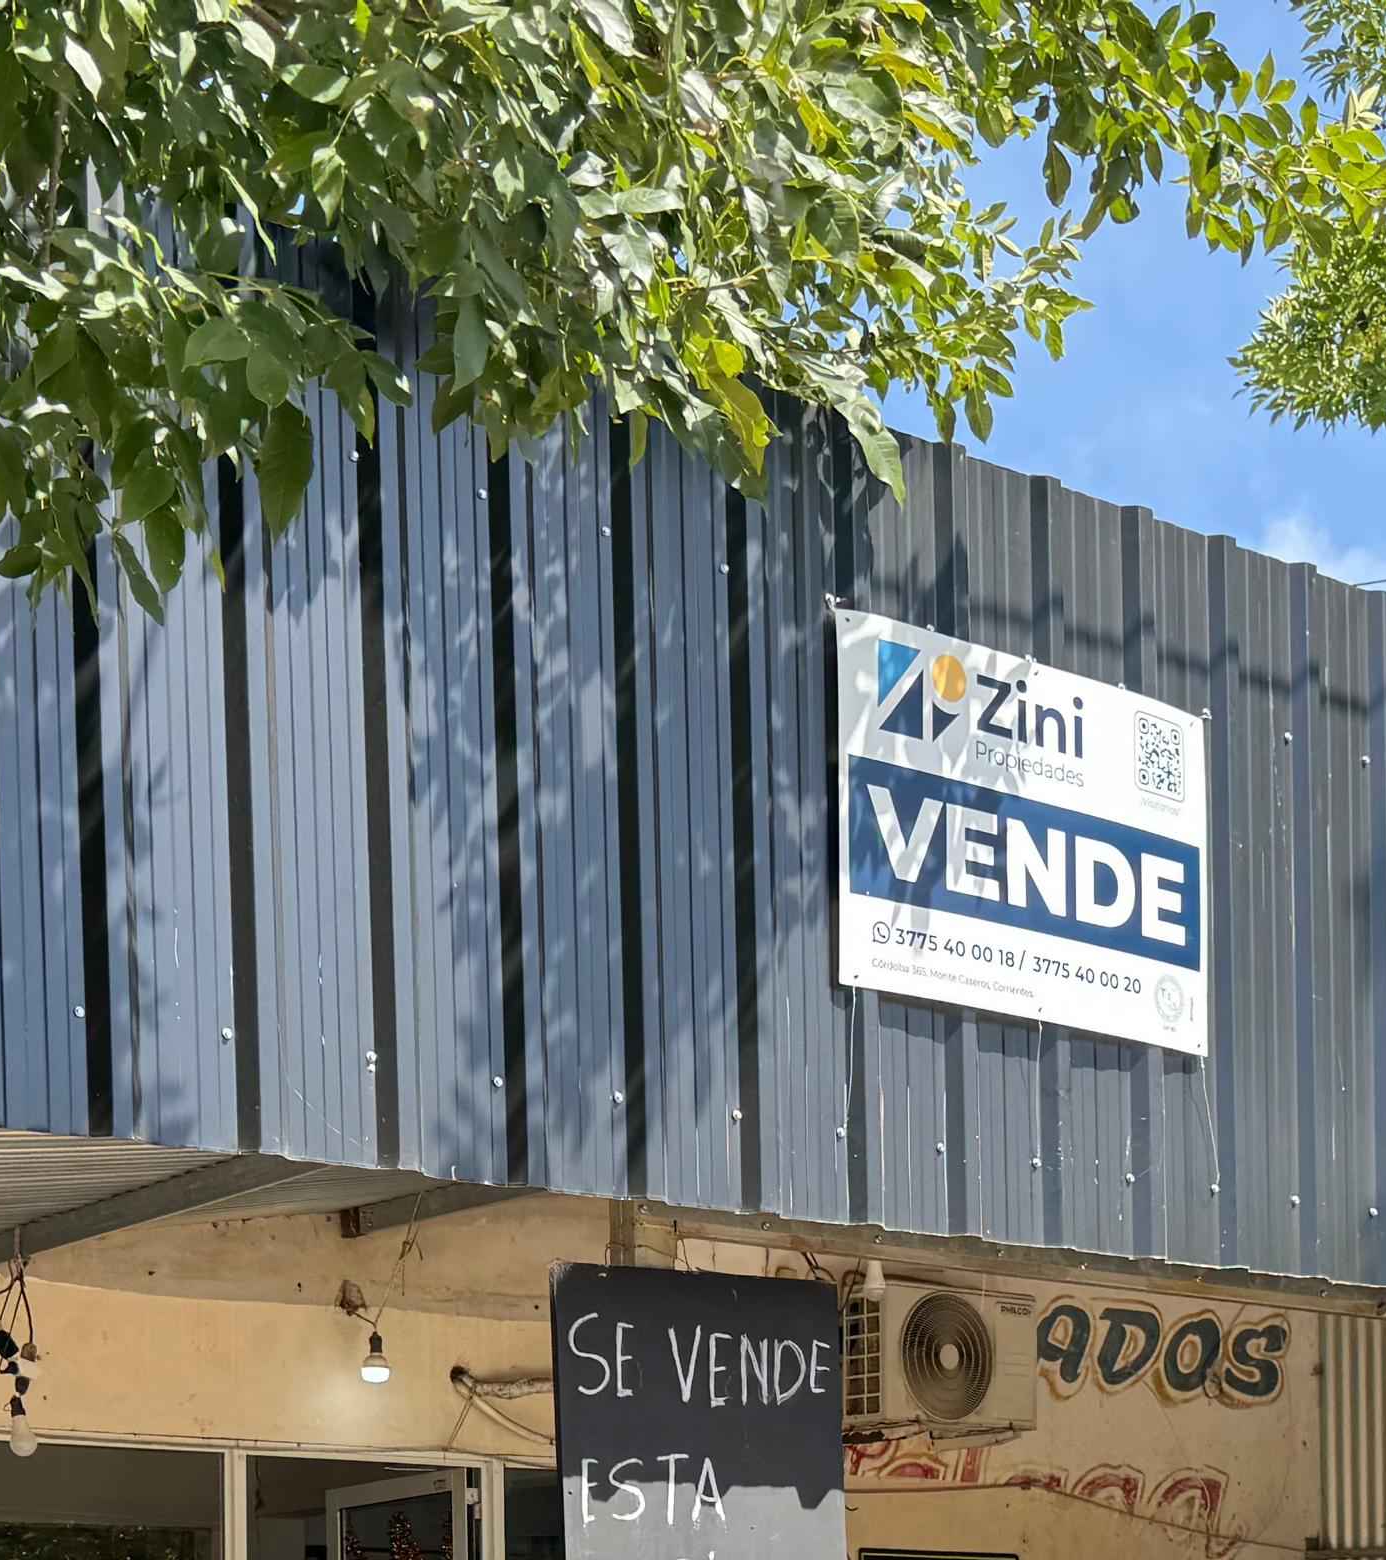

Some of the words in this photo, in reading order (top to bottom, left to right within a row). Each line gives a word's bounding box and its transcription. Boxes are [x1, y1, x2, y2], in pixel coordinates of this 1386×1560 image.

[976, 674, 1084, 760] Zini
[974, 740, 1085, 788] Propiedades
[866, 783, 1187, 947] VENDE
[895, 927, 939, 952] 3775
[943, 938, 966, 958] 40
[971, 944, 993, 963] 00
[998, 949, 1015, 968] 18
[1018, 949, 1027, 971] /
[1032, 955, 1070, 979] 3775
[1075, 965, 1096, 985] 40
[1100, 971, 1120, 990] 00
[1124, 976, 1142, 995] 20
[567, 1312, 635, 1398] SE
[667, 1323, 832, 1409] VENDE
[579, 1452, 730, 1529] ESTA
